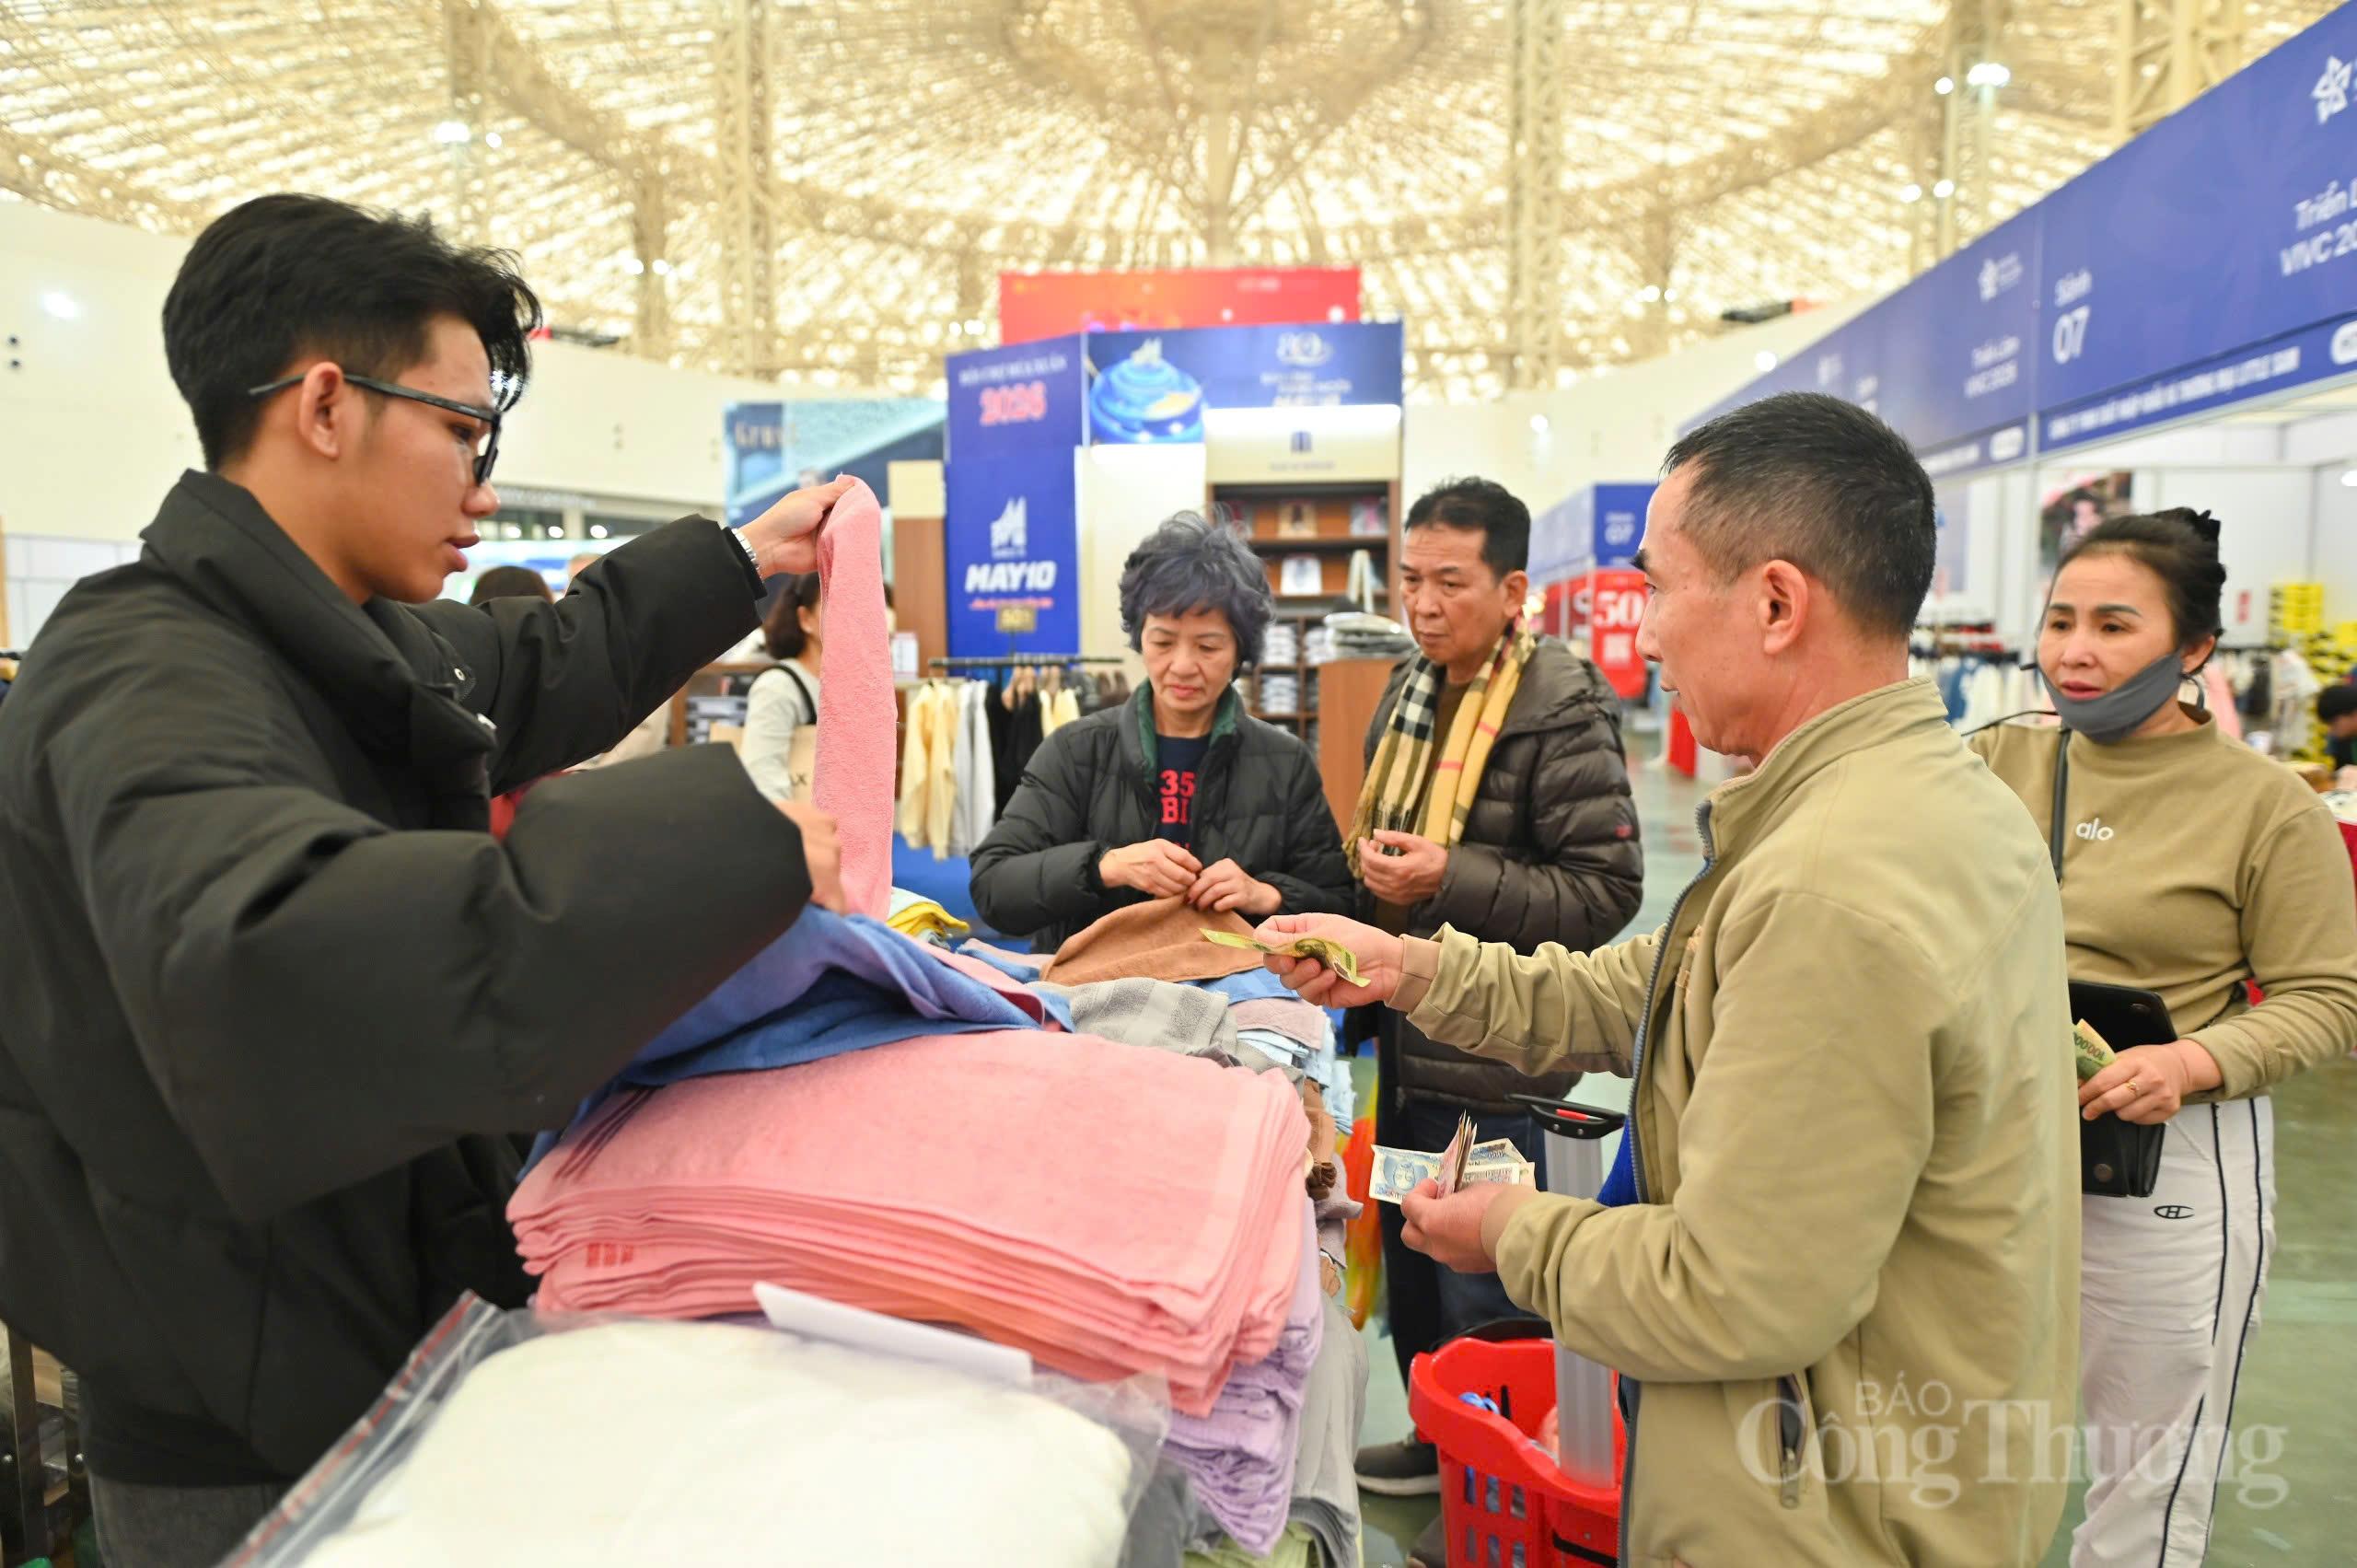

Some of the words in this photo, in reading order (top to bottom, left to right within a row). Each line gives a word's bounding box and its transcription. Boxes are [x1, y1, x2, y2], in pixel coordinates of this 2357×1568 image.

[2052, 305, 2091, 365] 07
[964, 560, 1058, 593] MAY10
[1160, 768, 1196, 798] 35
[2075, 817, 2115, 842] alo
